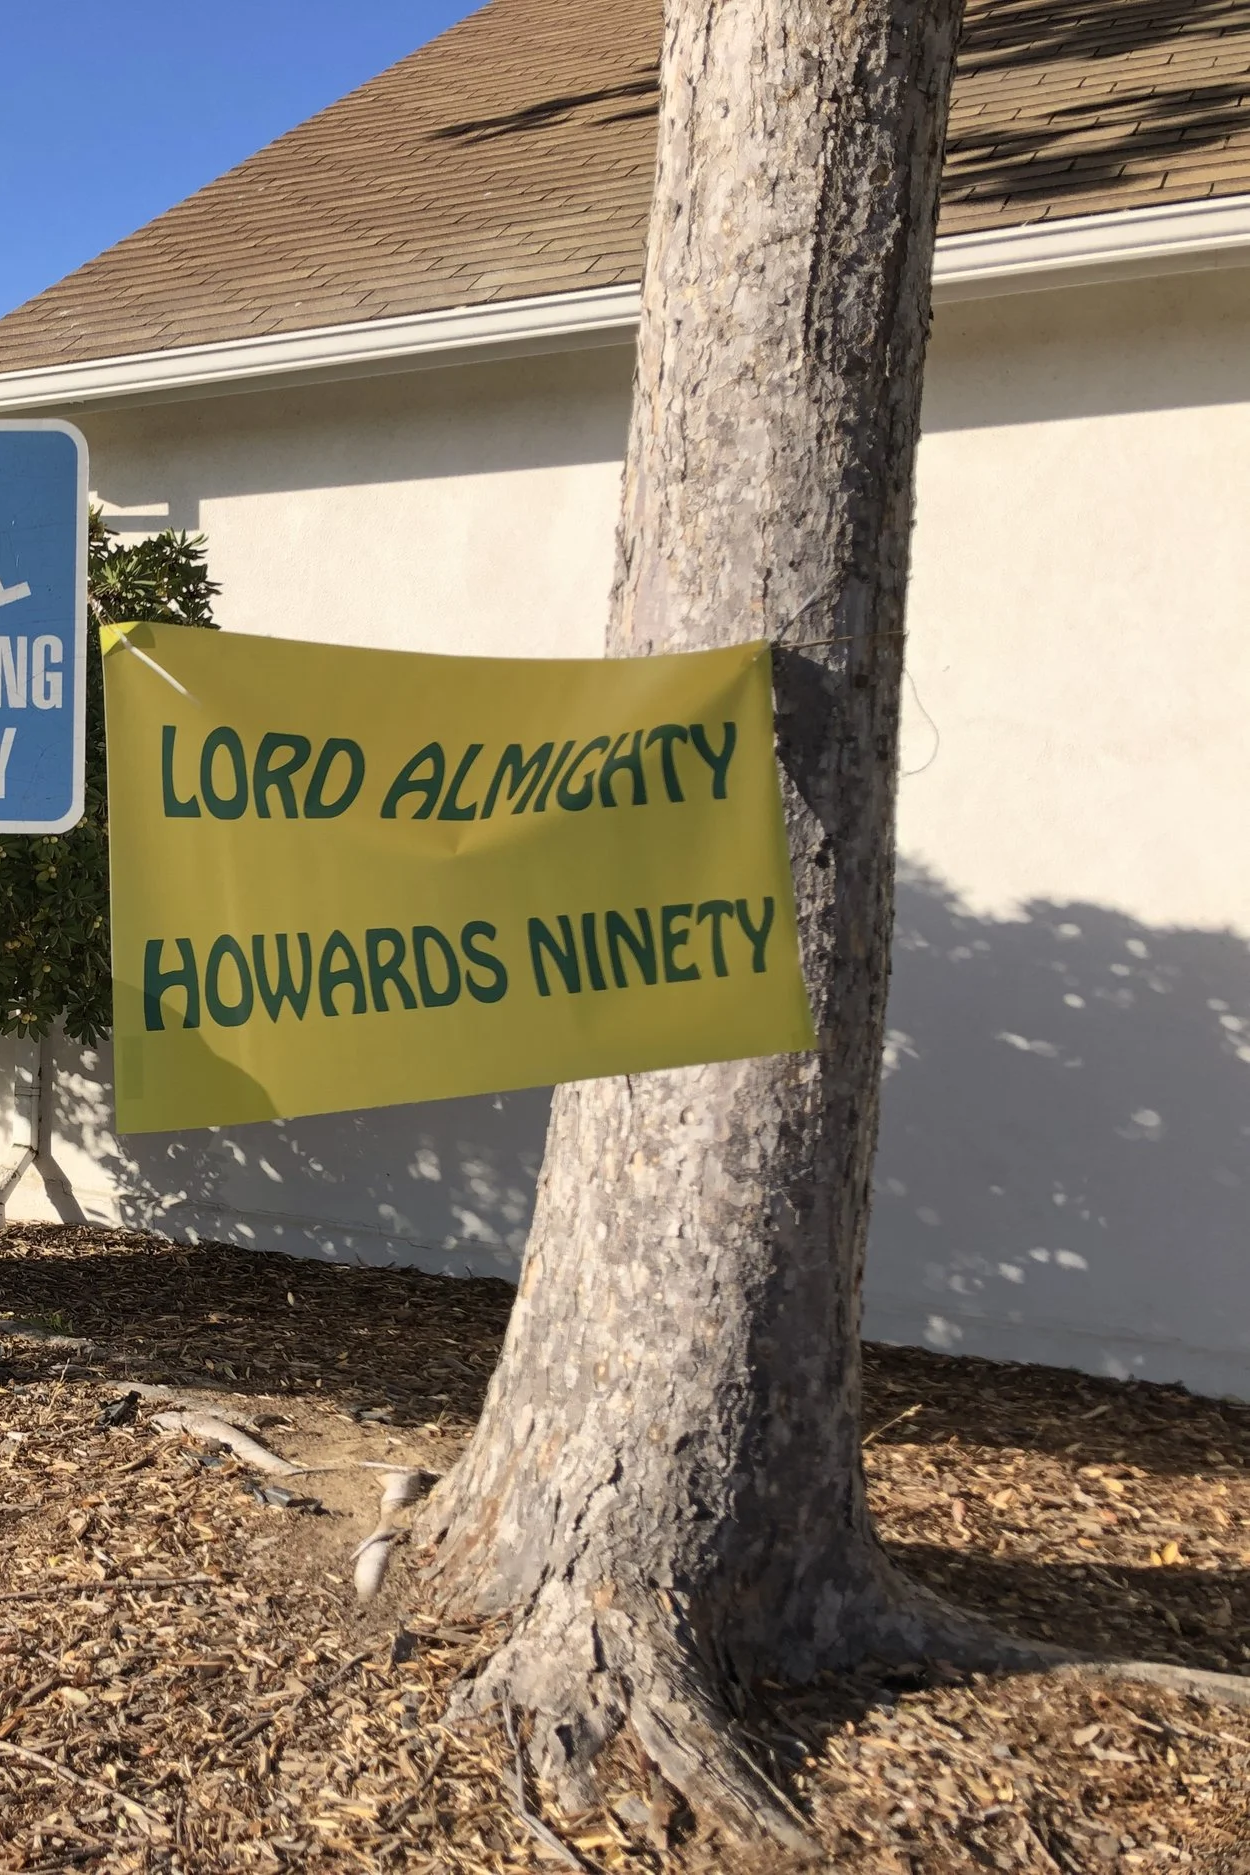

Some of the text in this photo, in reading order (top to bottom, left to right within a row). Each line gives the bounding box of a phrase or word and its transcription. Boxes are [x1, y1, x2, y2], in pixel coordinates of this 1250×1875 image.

[161, 721, 738, 821] LORD ALMIGHTY
[144, 896, 775, 1032] HOWARDS NINETY
